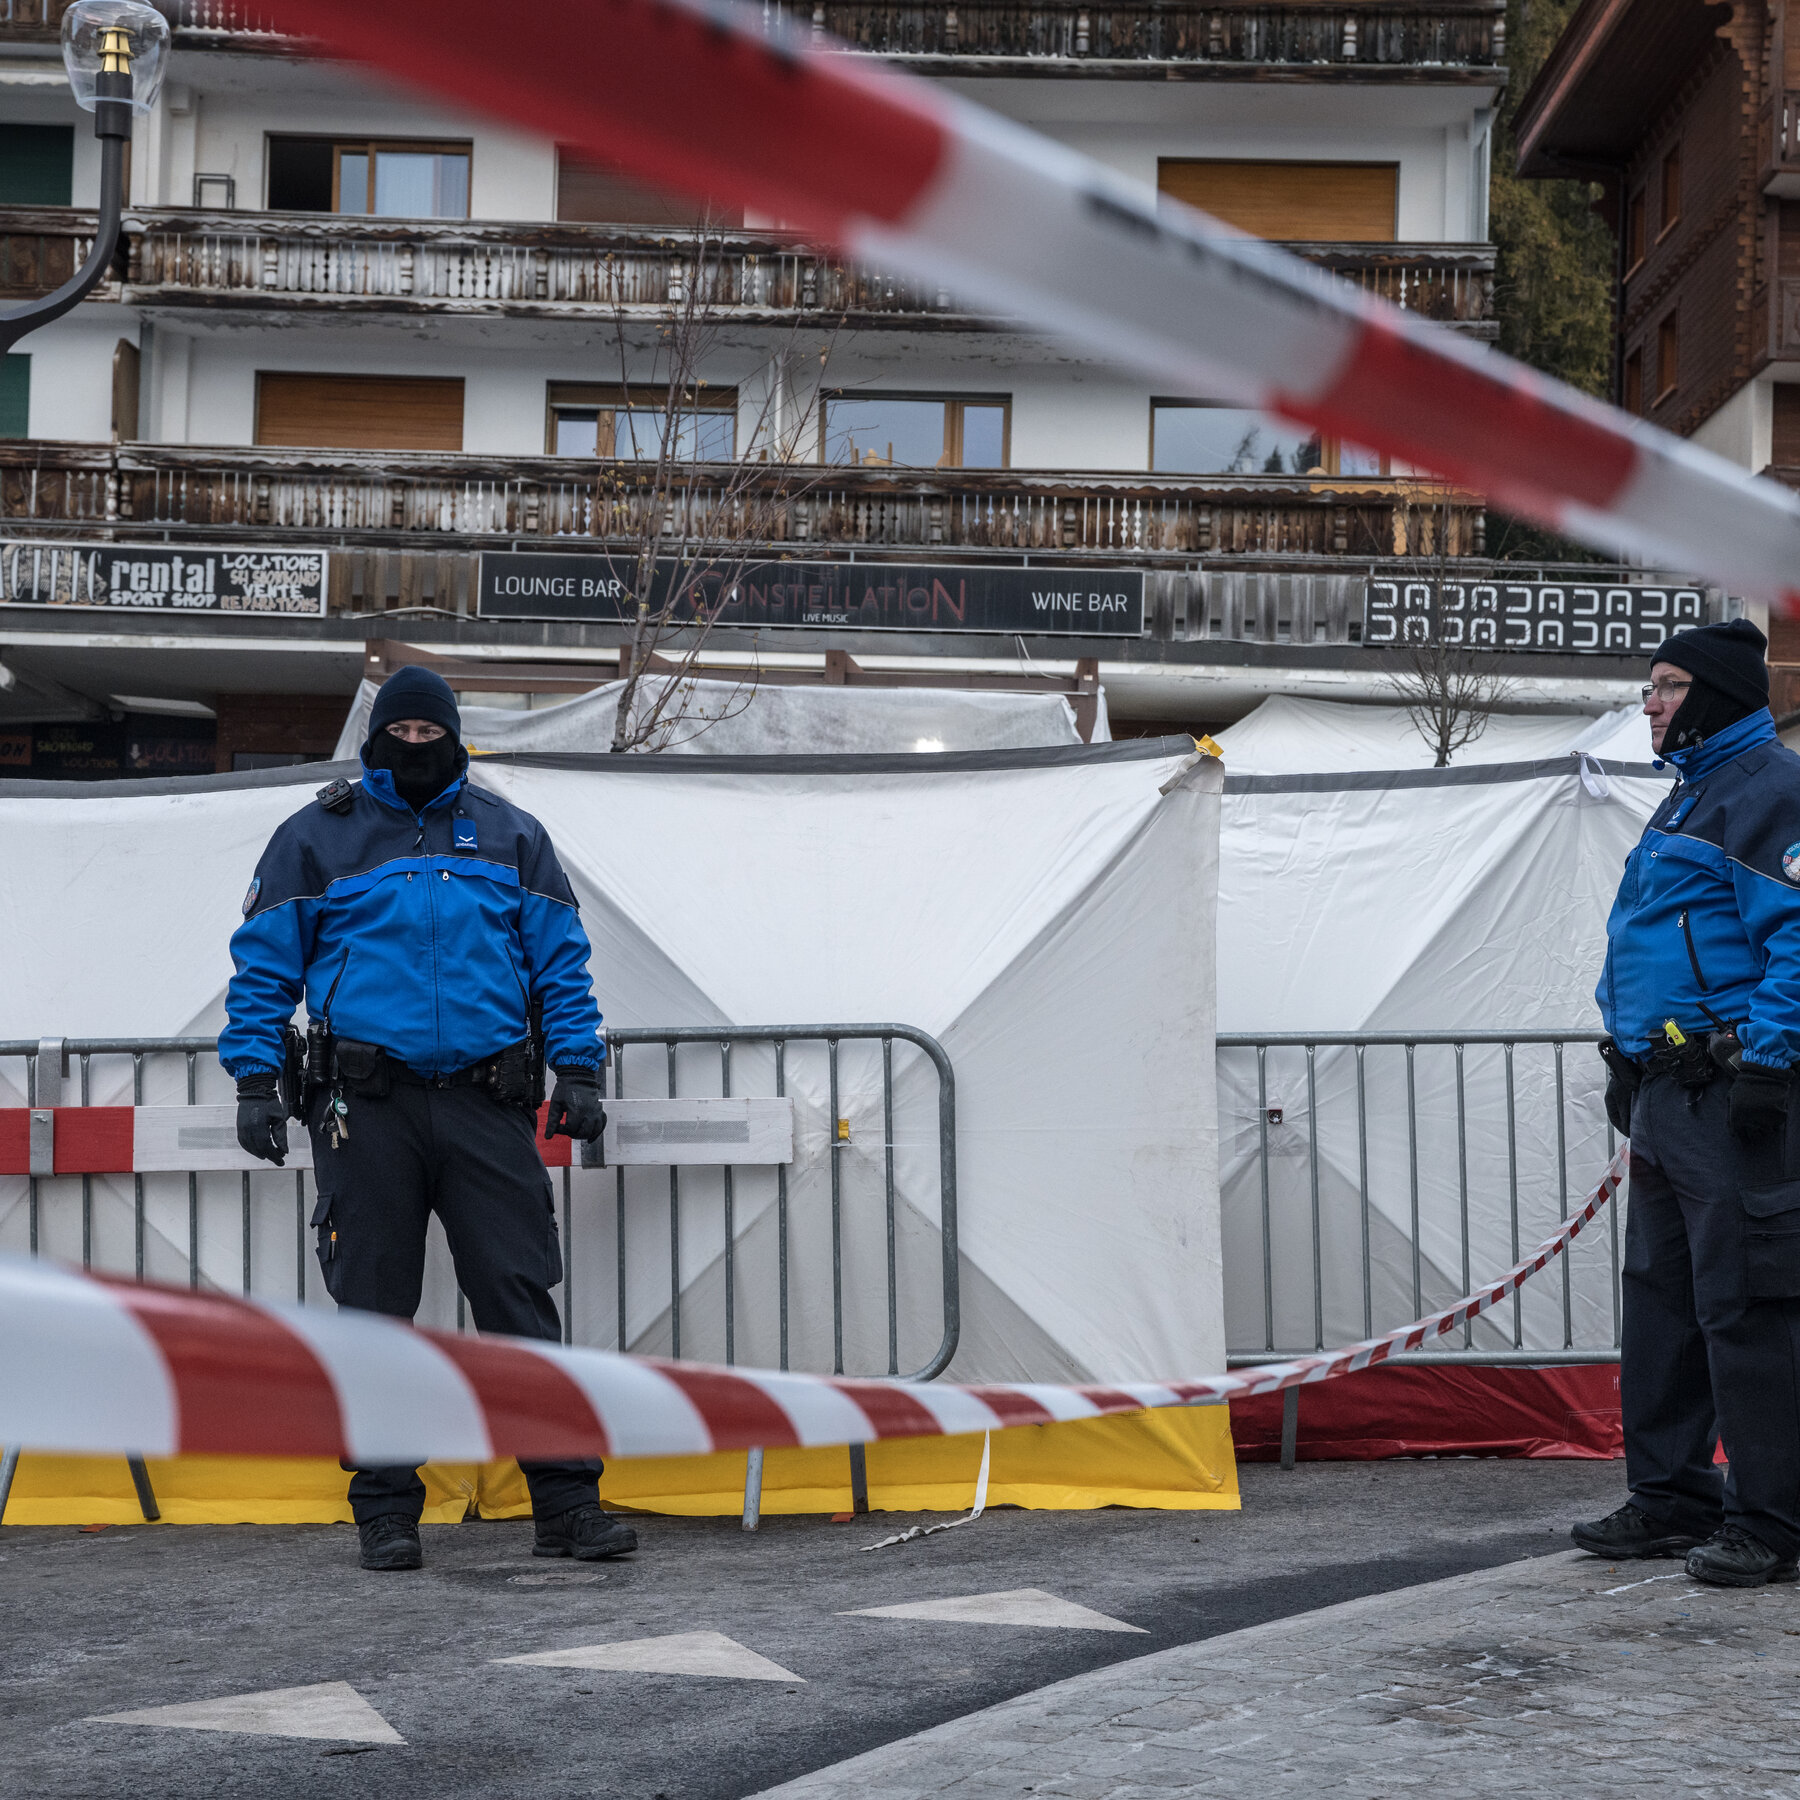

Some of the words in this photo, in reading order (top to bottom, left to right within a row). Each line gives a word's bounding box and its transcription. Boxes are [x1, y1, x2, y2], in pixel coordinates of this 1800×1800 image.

[221, 553, 320, 571] LOCATIONS
[0, 548, 103, 602] CIFIC
[111, 556, 215, 592] rental
[243, 583, 304, 599] VENTE
[495, 576, 576, 596] LOUNGE
[581, 578, 620, 598] BAR
[109, 590, 166, 606] SPORT
[171, 592, 217, 607] SHOP
[220, 595, 319, 612] REPARATIONS
[1032, 592, 1082, 612] WINE
[1088, 593, 1128, 612] BAR
[803, 613, 821, 623] LIVE
[822, 614, 849, 624] MUSIC
